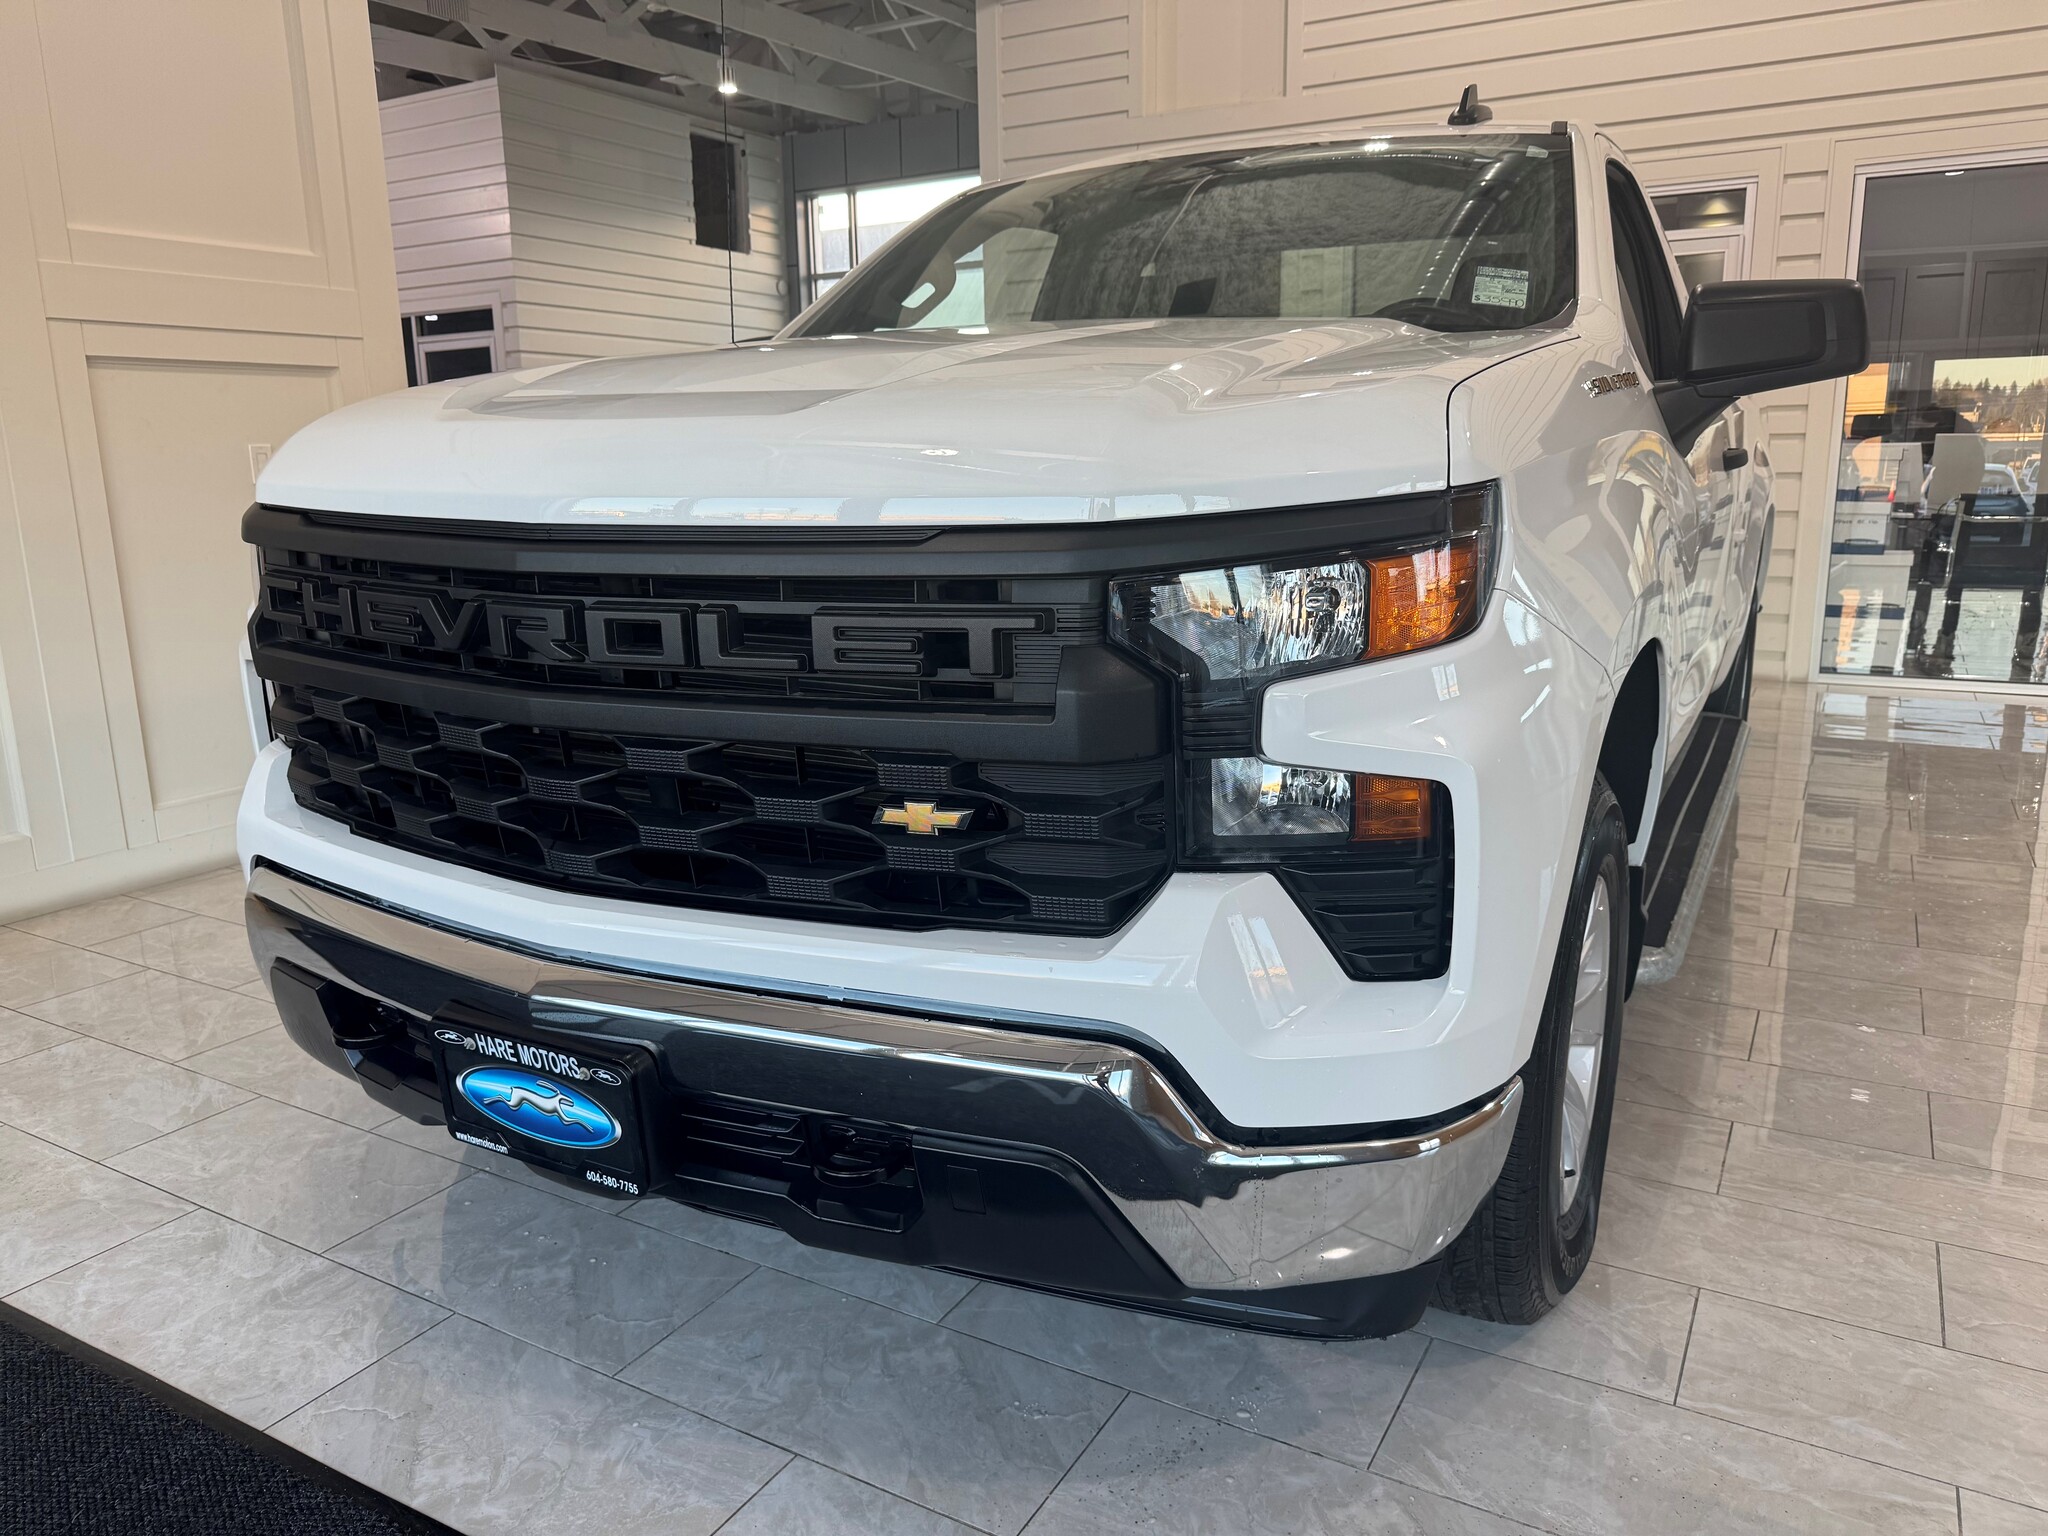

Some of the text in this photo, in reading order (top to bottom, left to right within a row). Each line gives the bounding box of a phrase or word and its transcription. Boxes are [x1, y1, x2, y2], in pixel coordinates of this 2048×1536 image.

[258, 571, 1054, 679] CHEVROLET
[475, 1033, 582, 1080] HARE MOTORS
[586, 1170, 639, 1195] 604-580-7755
